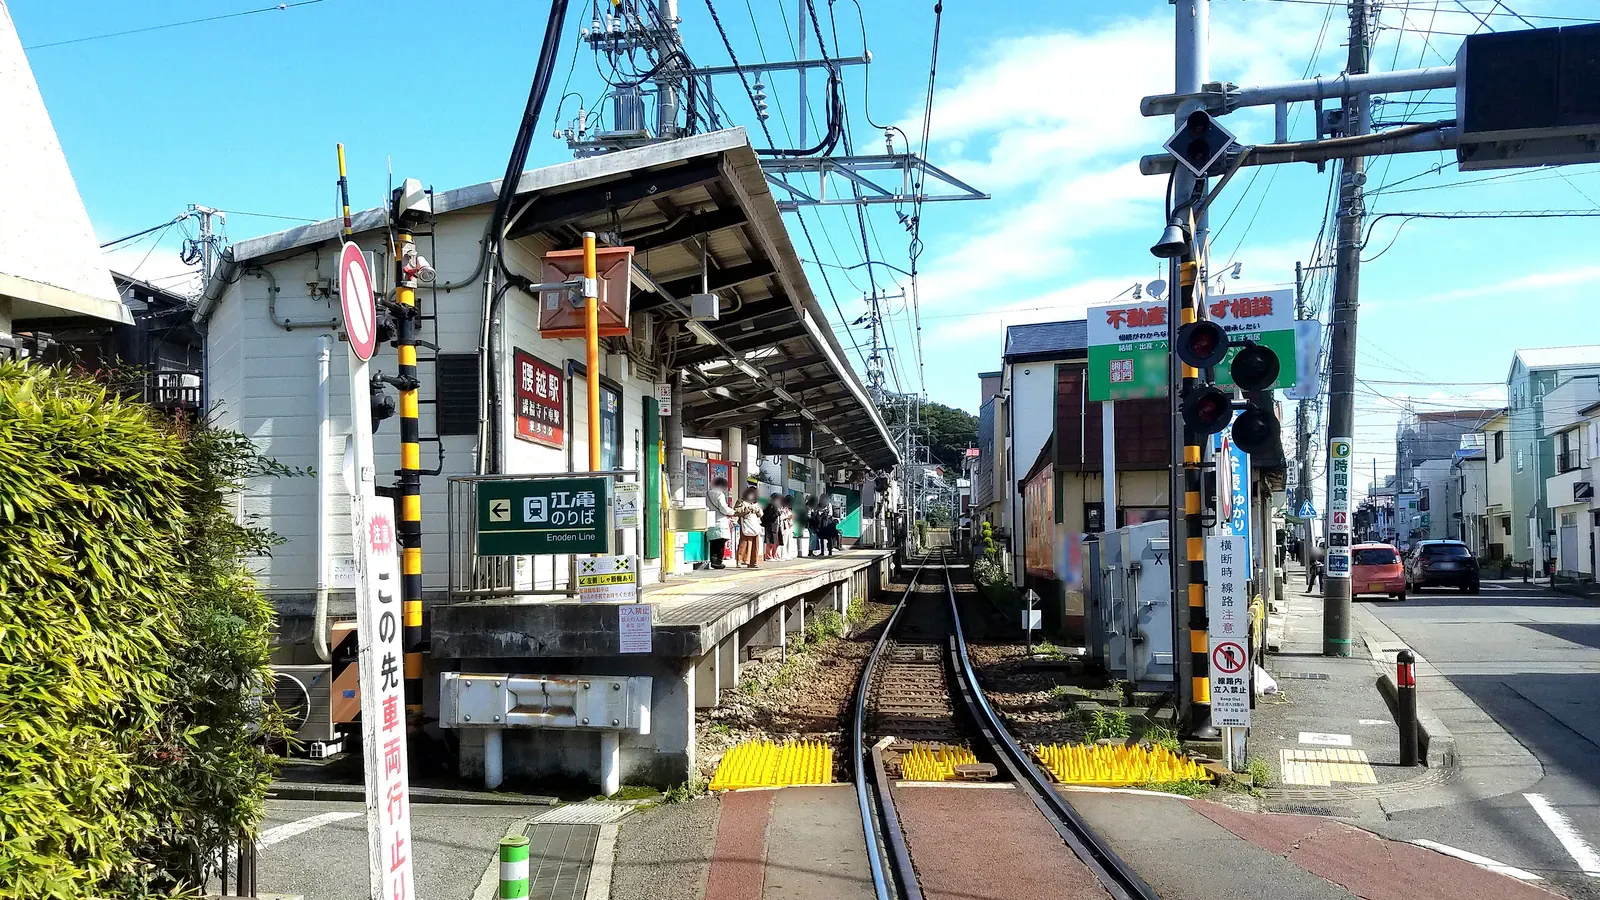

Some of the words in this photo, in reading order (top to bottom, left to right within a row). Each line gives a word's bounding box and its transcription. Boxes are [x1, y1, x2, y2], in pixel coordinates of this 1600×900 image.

[1106, 306, 1167, 329] 不動産
[522, 361, 560, 403] 腰越駅
[1333, 459, 1348, 502] 時間貸
[551, 491, 596, 508] 江ノ電
[551, 509, 596, 526] のりば
[546, 533, 577, 542] Enoden
[578, 533, 596, 541] Line
[1220, 539, 1235, 634] 横断時線路注意
[620, 607, 650, 616] 立入禁止
[1218, 677, 1242, 685] 線路内
